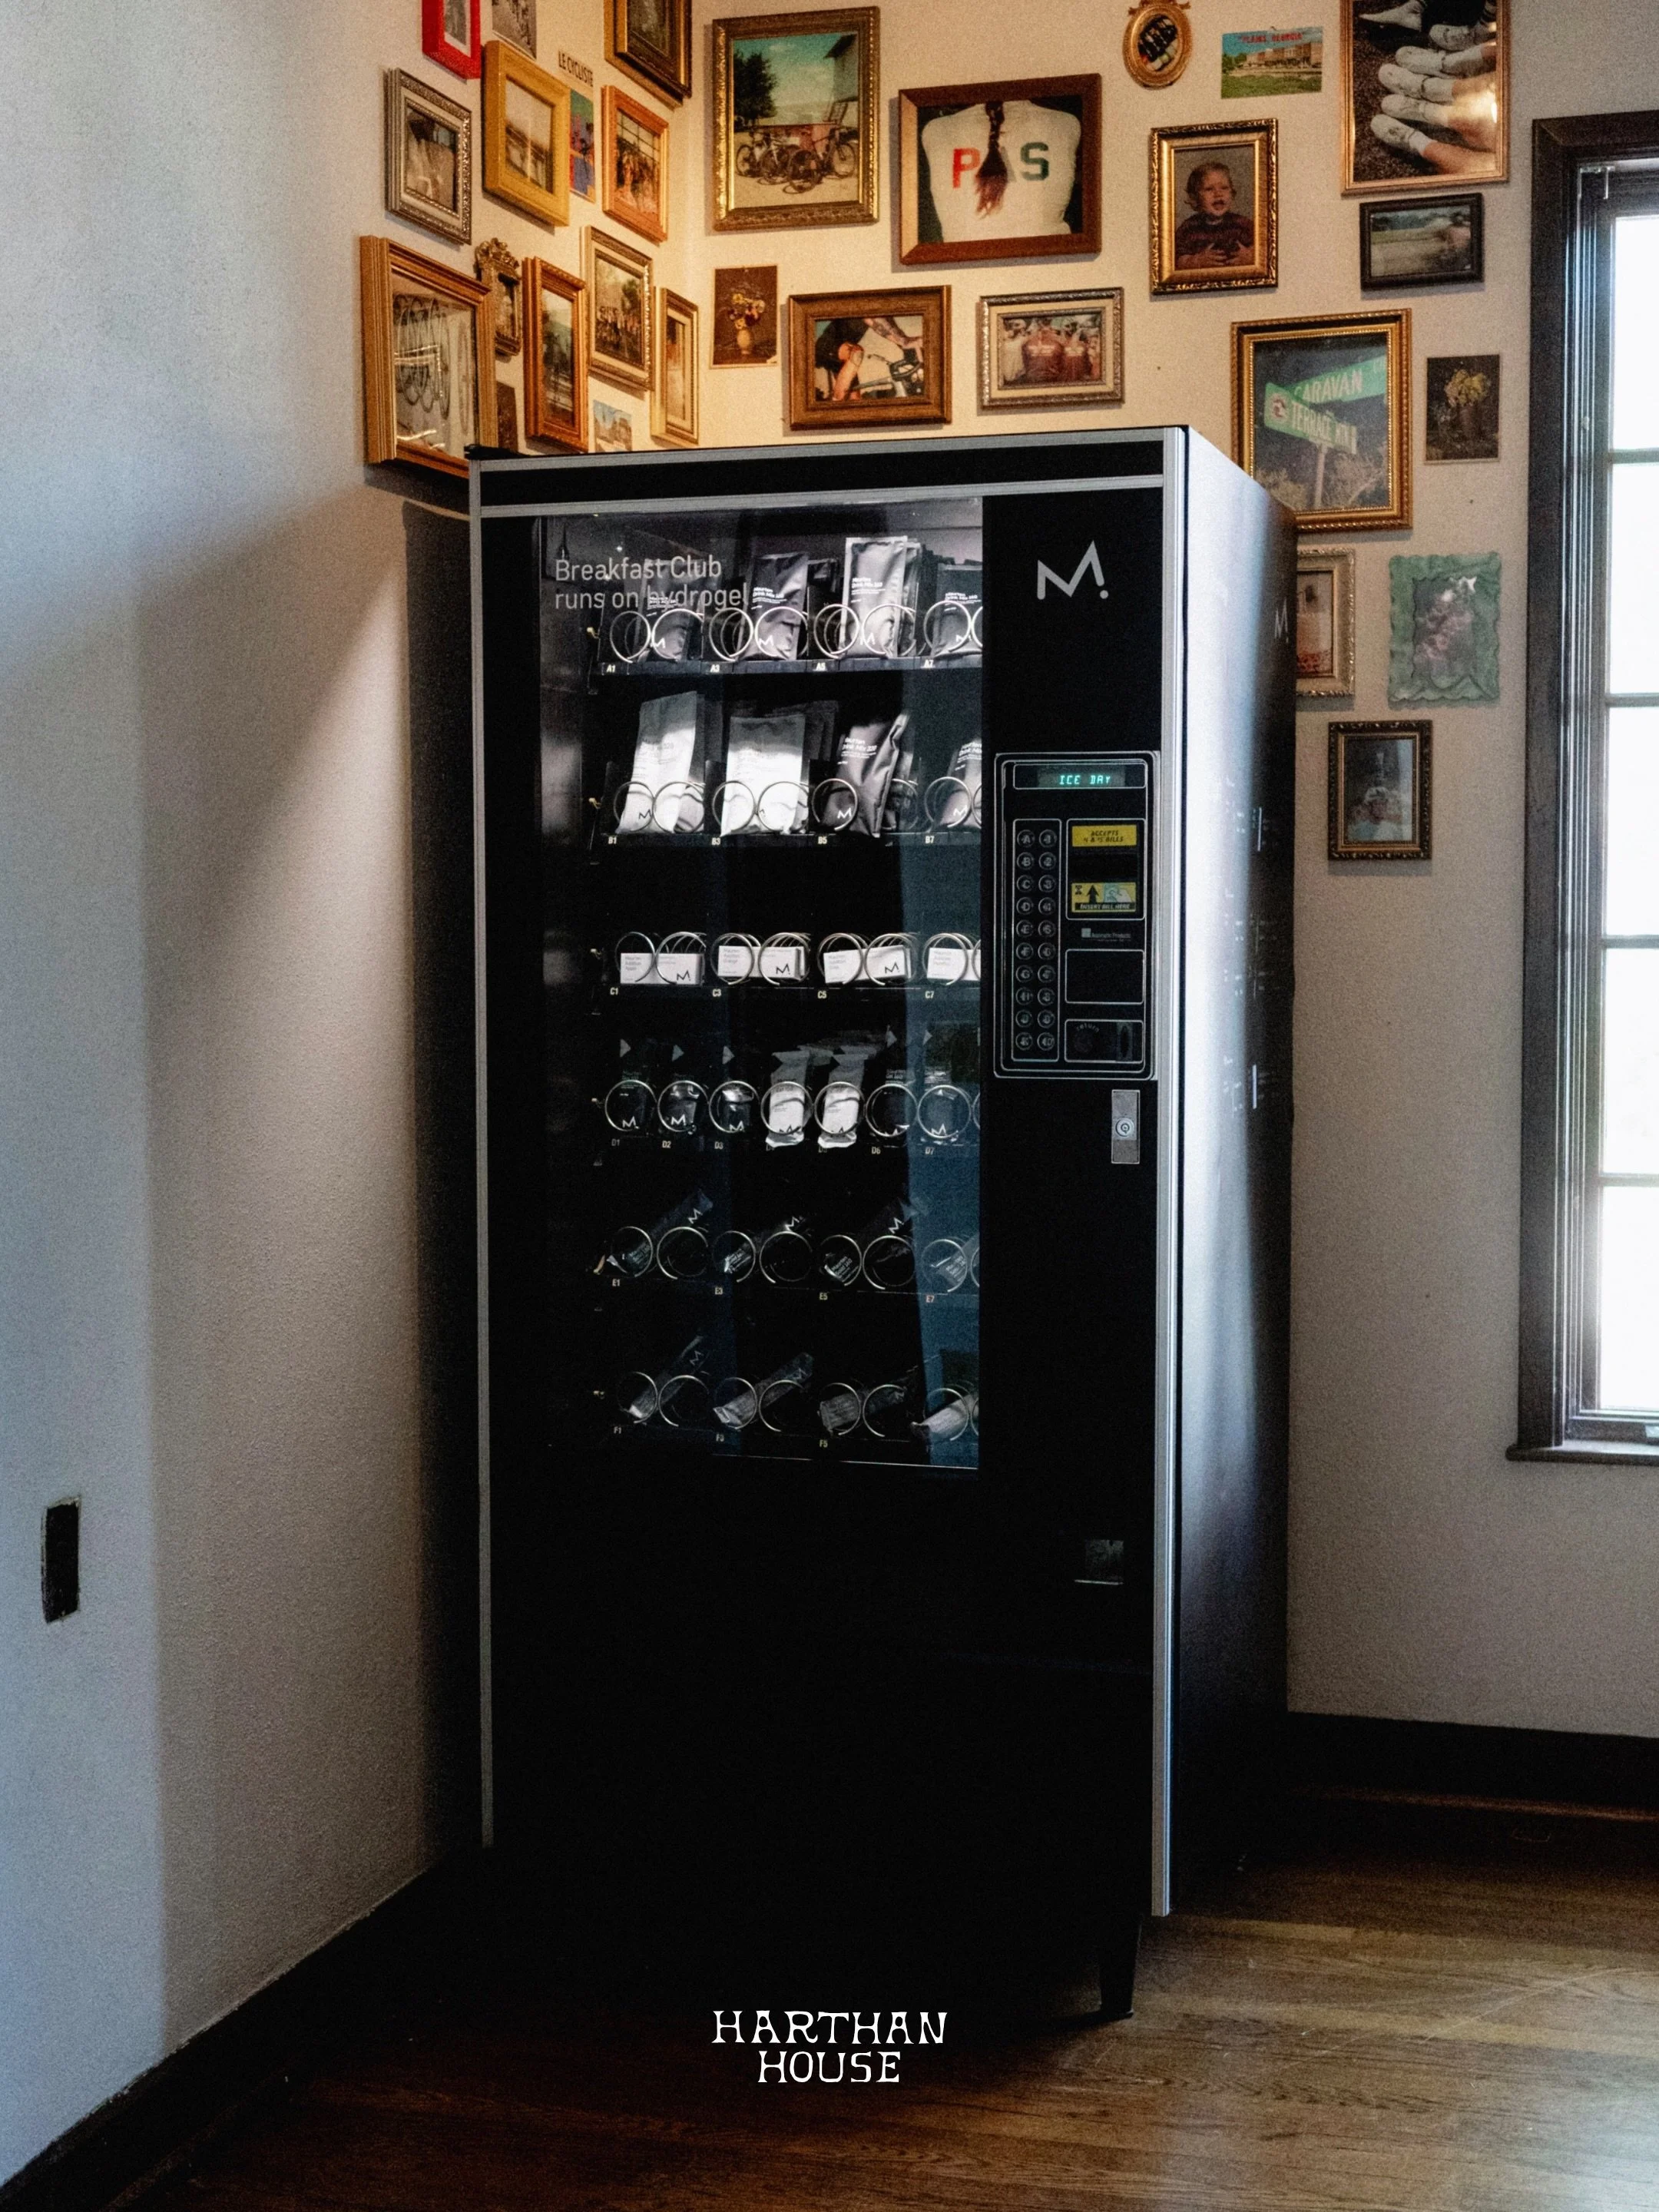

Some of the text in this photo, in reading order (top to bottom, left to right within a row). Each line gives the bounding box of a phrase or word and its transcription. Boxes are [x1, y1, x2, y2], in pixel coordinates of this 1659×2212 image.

[558, 50, 594, 88] LE CYCLISTE
[555, 555, 722, 581] Breakfast Club
[555, 582, 748, 613] runs on hydrogel
[924, 659, 934, 667] A7
[606, 664, 616, 673] A1
[710, 664, 720, 673] A3
[1059, 775, 1111, 785] ICE DAY
[818, 836, 828, 844] B5
[610, 987, 619, 995] C1
[712, 988, 722, 997] C3
[817, 990, 827, 998] C5
[925, 990, 935, 998] C7
[1076, 1022, 1101, 1033] return
[611, 1138, 621, 1147] D1
[662, 1140, 671, 1148] D2
[714, 1141, 724, 1150] D3
[925, 1147, 935, 1155] D7
[819, 1292, 829, 1300] E5
[614, 1426, 622, 1435] F1
[819, 1439, 829, 1448] F5
